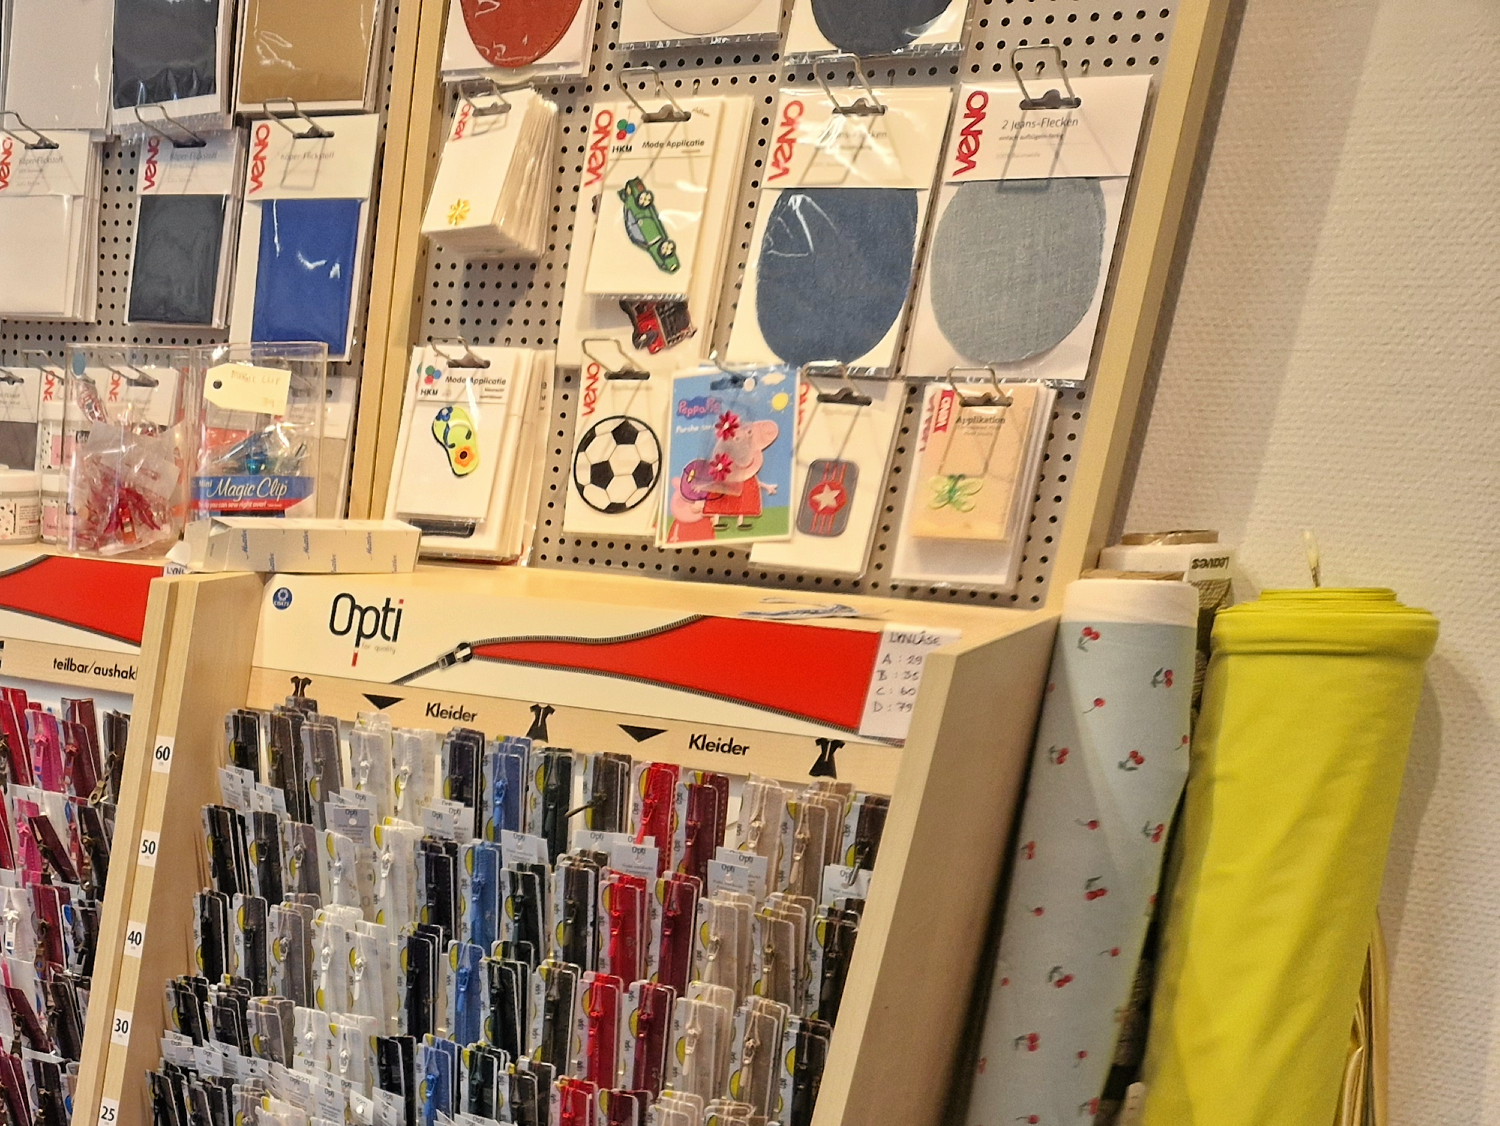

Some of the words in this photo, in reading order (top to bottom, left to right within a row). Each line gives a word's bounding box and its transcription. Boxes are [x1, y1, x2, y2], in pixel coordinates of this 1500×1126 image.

[1001, 119, 1009, 130] 2
[612, 145, 633, 153] HKM
[206, 477, 255, 502] Magic
[256, 477, 287, 502] Clip
[329, 592, 405, 650] Opti
[52, 656, 138, 681] teilbar/aushak
[425, 701, 478, 723] Kleider
[155, 745, 171, 761] 60
[688, 733, 751, 757] Kleider
[141, 839, 156, 855] 50
[127, 930, 142, 946] 40
[114, 1018, 129, 1034] 30
[100, 1105, 116, 1122] 25
